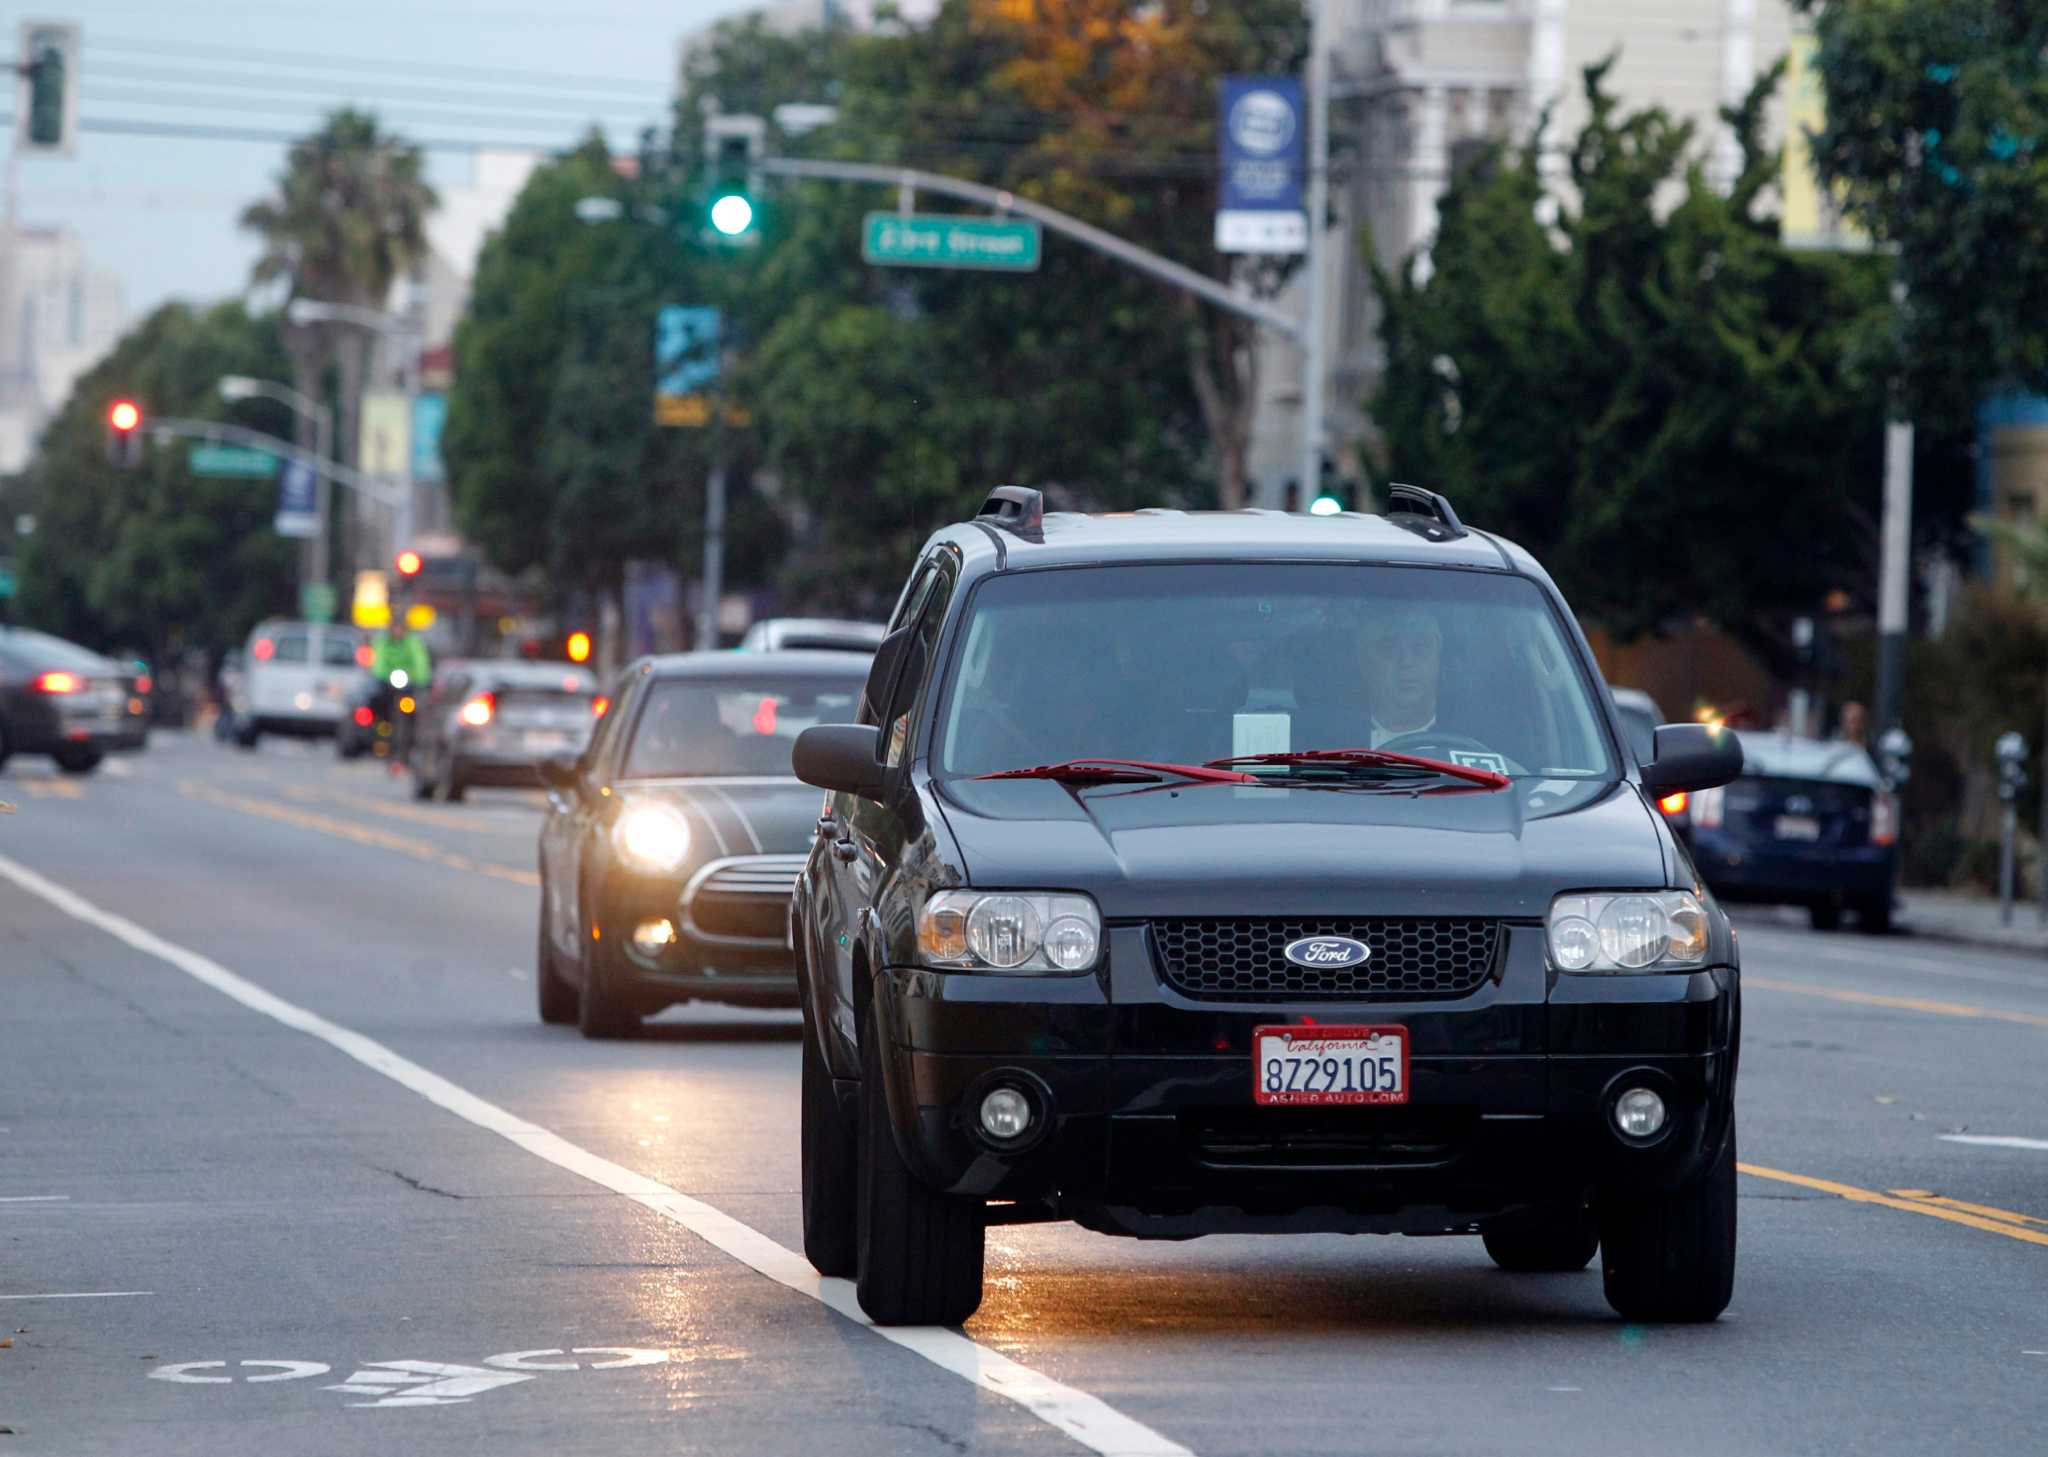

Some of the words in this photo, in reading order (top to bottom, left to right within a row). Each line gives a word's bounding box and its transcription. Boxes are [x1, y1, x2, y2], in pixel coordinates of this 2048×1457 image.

[947, 227, 1025, 256] Street
[1304, 942, 1352, 961] Ford
[1286, 1039, 1378, 1057] California
[1266, 1057, 1396, 1092] 8Z29105
